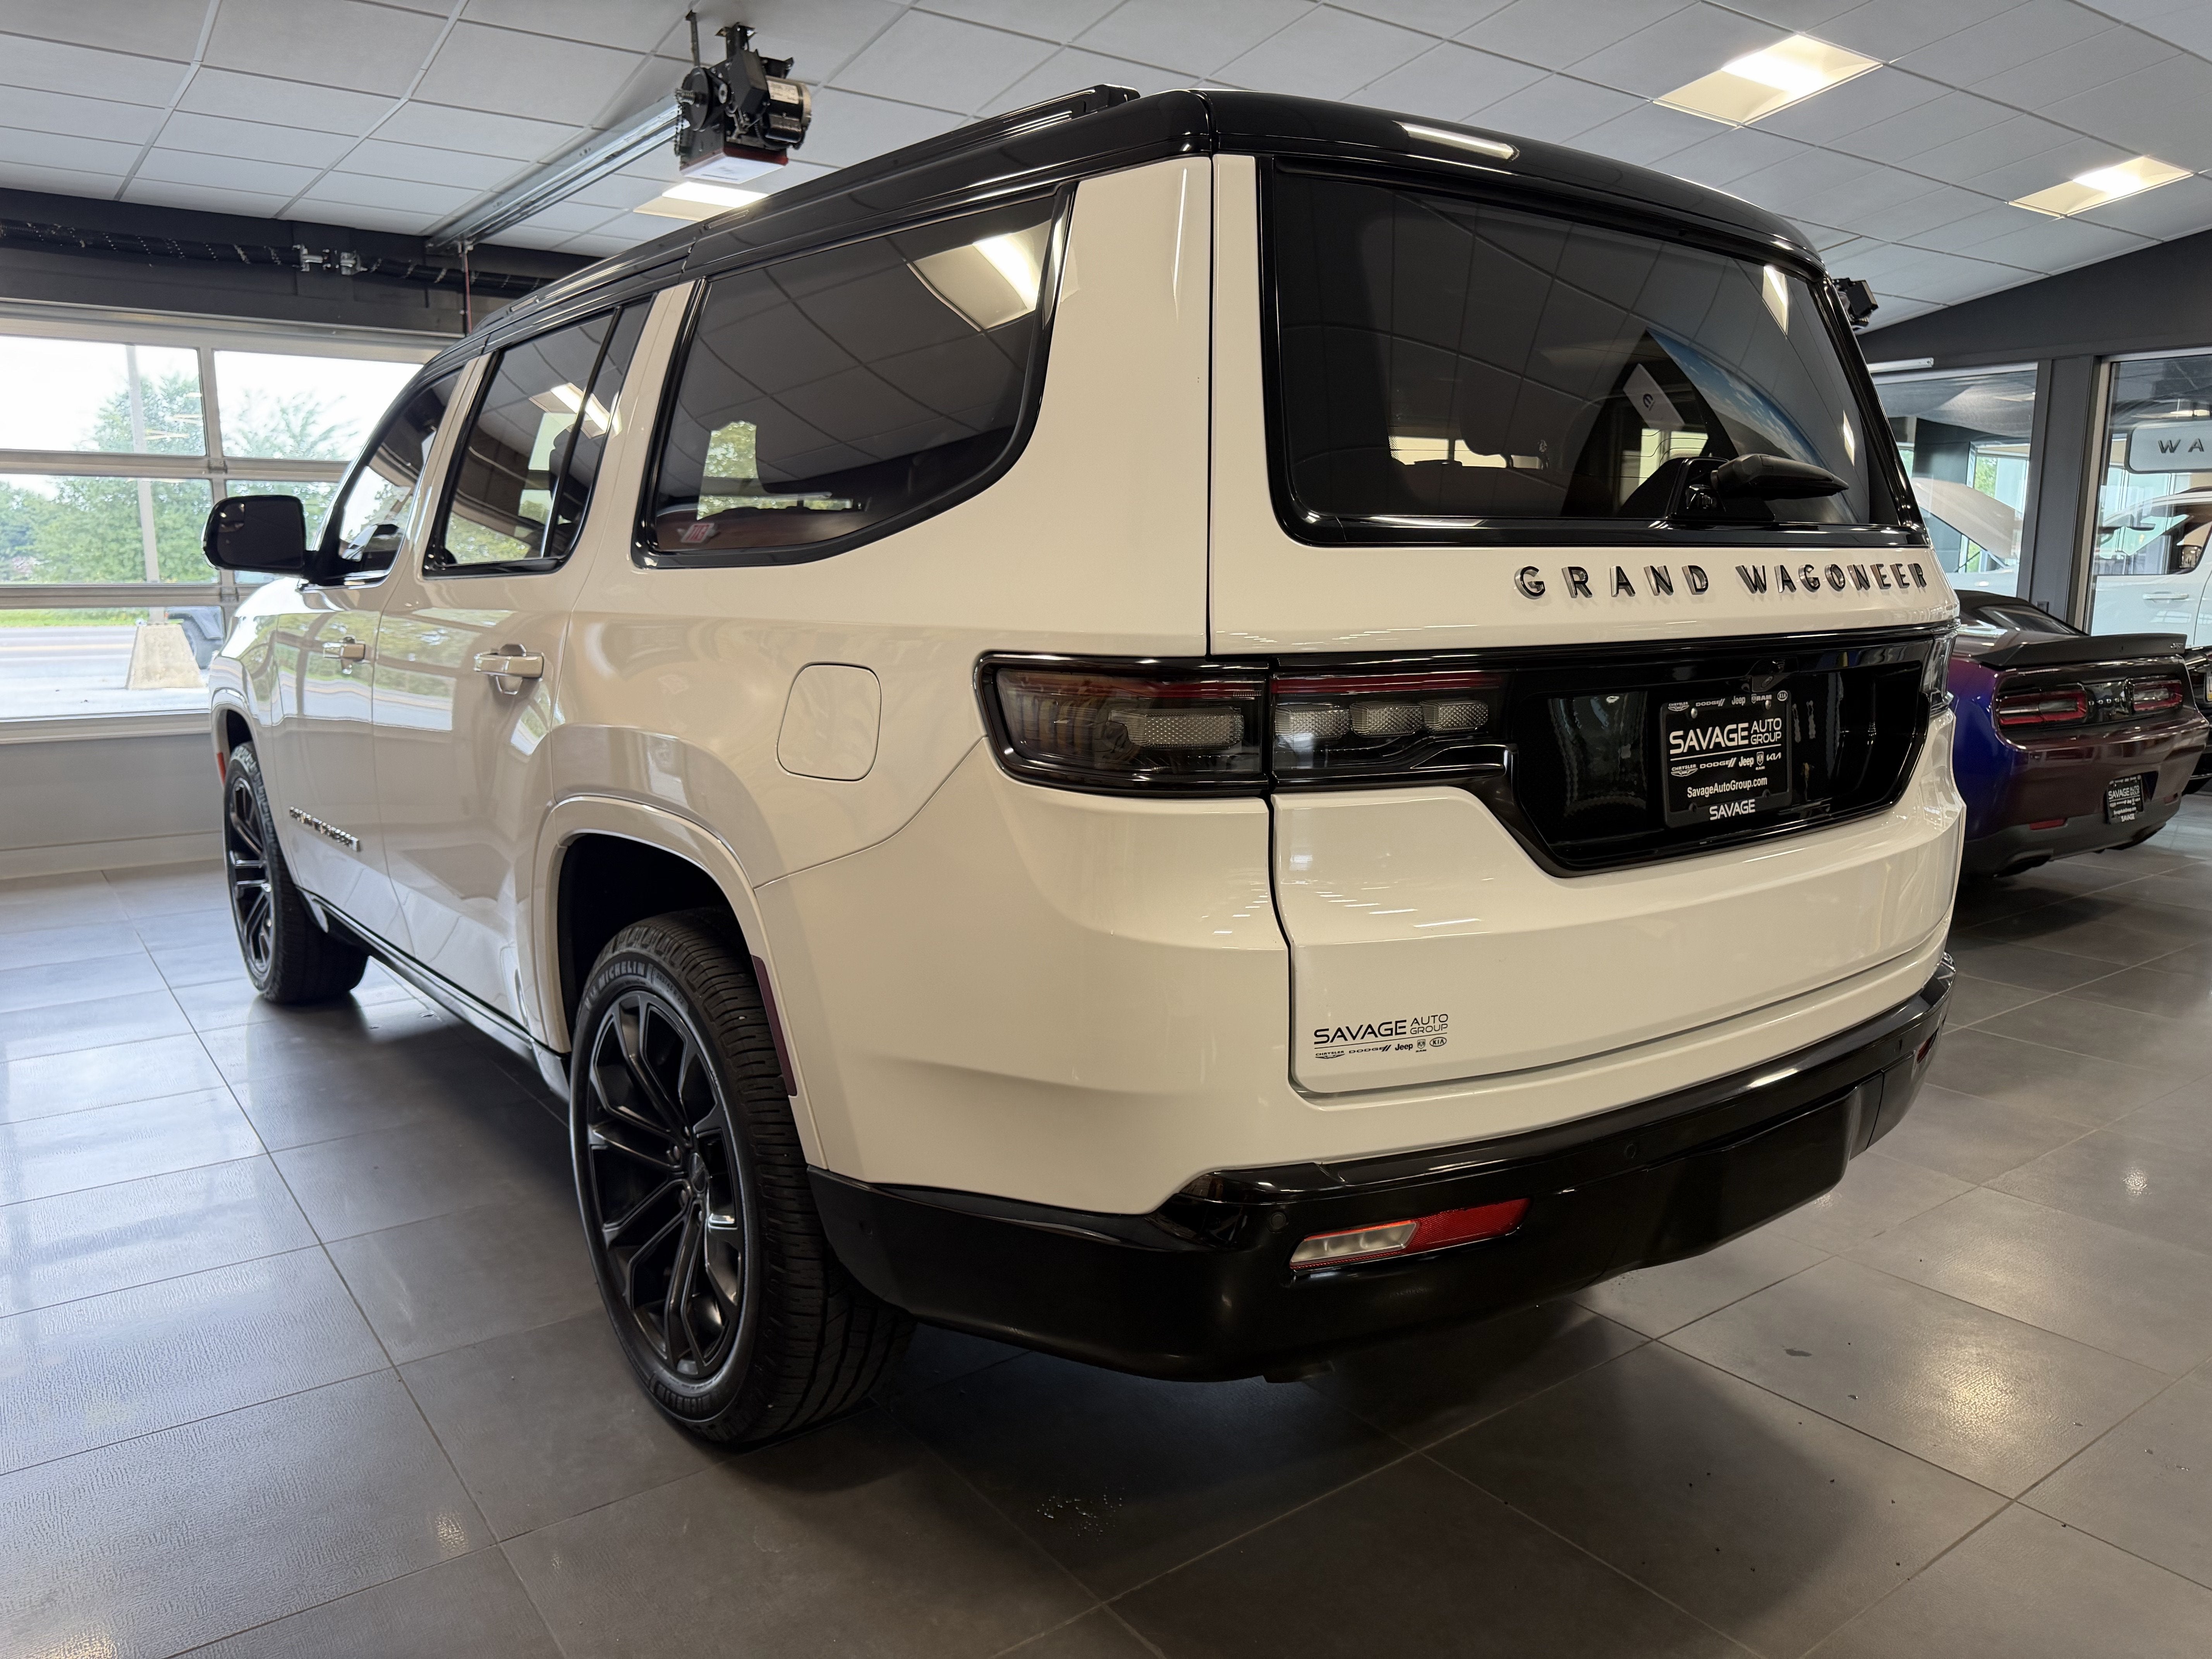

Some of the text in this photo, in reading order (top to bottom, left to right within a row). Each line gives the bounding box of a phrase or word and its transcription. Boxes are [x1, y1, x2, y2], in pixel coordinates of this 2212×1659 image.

[1514, 563, 1928, 599] GRAND WAGONEER
[1731, 696, 1746, 706] Jeep
[1669, 718, 1782, 754] SAVAGE AUTO
[1750, 731, 1781, 745] GROUP
[1700, 760, 1731, 769] DODGE
[1739, 756, 1754, 767] Jeep
[1766, 752, 1781, 761] KIA
[1687, 777, 1767, 798] SavageAutoGroup.com
[2108, 787, 2130, 800] SAVAGE
[1709, 799, 1756, 821] SAVAGE
[599, 960, 645, 990] MICHELIN
[1314, 1014, 1448, 1044] SAVAGE AUTO
[1410, 1024, 1448, 1035] GROUP
